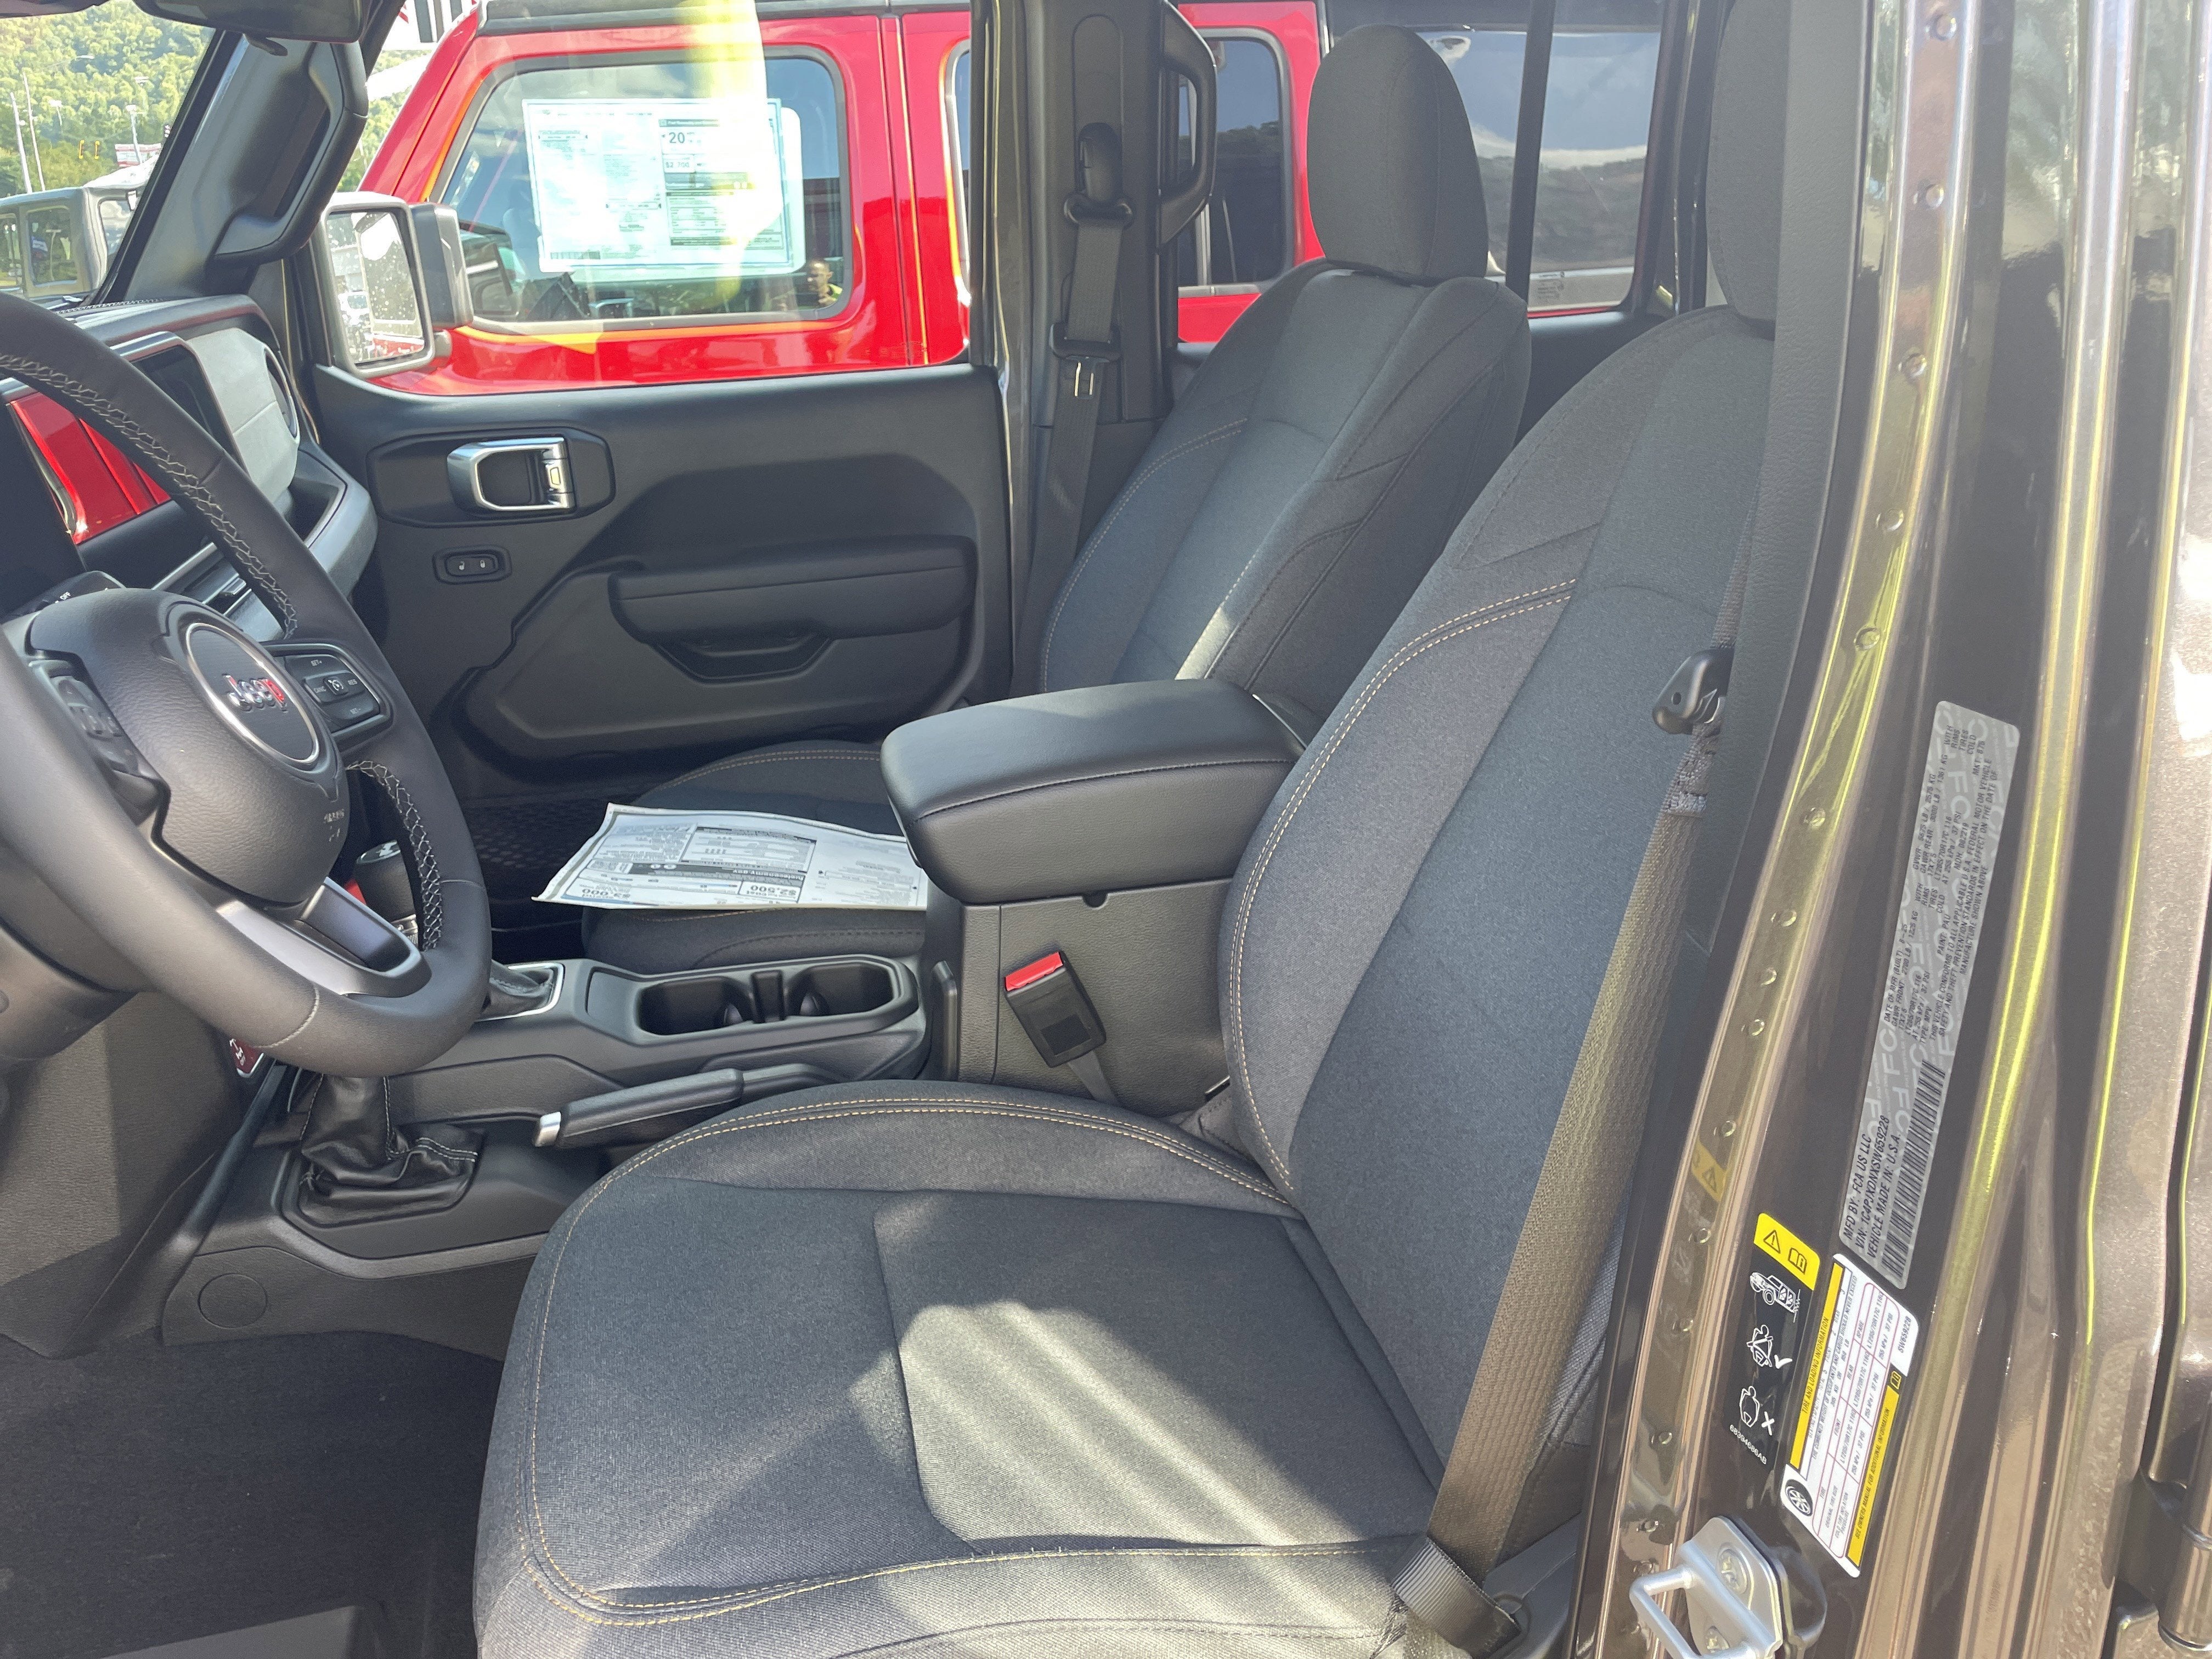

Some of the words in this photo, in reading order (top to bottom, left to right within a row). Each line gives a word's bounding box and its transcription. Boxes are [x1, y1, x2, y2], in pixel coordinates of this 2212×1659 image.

[669, 132, 685, 144] 20
[60, 591, 71, 600] OFF
[223, 675, 285, 708] Jeep
[1943, 724, 1954, 746] WITH
[1958, 728, 1969, 751] TIRES
[1966, 733, 1977, 755] COLD
[1978, 757, 1992, 791] VEHICLE
[1989, 769, 1999, 781] OF
[1984, 782, 1996, 804] DATE
[1973, 791, 1985, 820] MOTOR
[1981, 804, 1991, 821] THE
[1966, 820, 1979, 856] FEDERAL
[1979, 820, 1988, 834] ON
[1973, 834, 1985, 864] EFFECT
[1918, 849, 1929, 874] GAWR
[1971, 864, 1979, 874] IN
[1941, 873, 1949, 886] AT
[1914, 881, 1923, 903] WITH
[1920, 886, 1931, 907] RIMS
[1927, 887, 1938, 911] TIRES
[1936, 893, 1945, 915] COLD
[1952, 880, 1968, 927] APPLICABLE
[1962, 873, 1978, 921] STANDARDS
[1949, 926, 1959, 943] ALL
[1952, 920, 1968, 968] PREVENTION
[1946, 941, 1955, 953] TO
[1938, 952, 1953, 994] CONFORMS
[1947, 967, 1959, 992] THEFT
[1887, 992, 1894, 1004] OF
[1932, 993, 1944, 1024] VEHICLE
[1944, 991, 1954, 1009] AND
[1883, 1002, 1893, 1023] DATE
[1890, 1003, 1900, 1028] GAWR
[1938, 1008, 1950, 1038] SAFETY
[1911, 1028, 1919, 1041] AT
[1928, 1023, 1938, 1042] THIS
[1859, 1131, 1871, 1156] LLC
[1885, 1127, 1901, 1166] U.S.A.
[1855, 1152, 1867, 1172] US
[1882, 1163, 1894, 1184] IN:
[1851, 1169, 1864, 1195] FCA
[1847, 1192, 1860, 1216] BY:
[1875, 1181, 1890, 1216] MADE
[1842, 1212, 1856, 1242] MFD
[1855, 1223, 1868, 1252] VIN:
[1866, 1213, 1884, 1261] VEHICLE
[1814, 1314, 1829, 1361] INFORMATION
[1897, 1314, 1911, 1355] SW659228
[1808, 1357, 1819, 1387] LOADING
[1804, 1384, 1813, 1401] AND
[1801, 1397, 1810, 1415] TIRE
